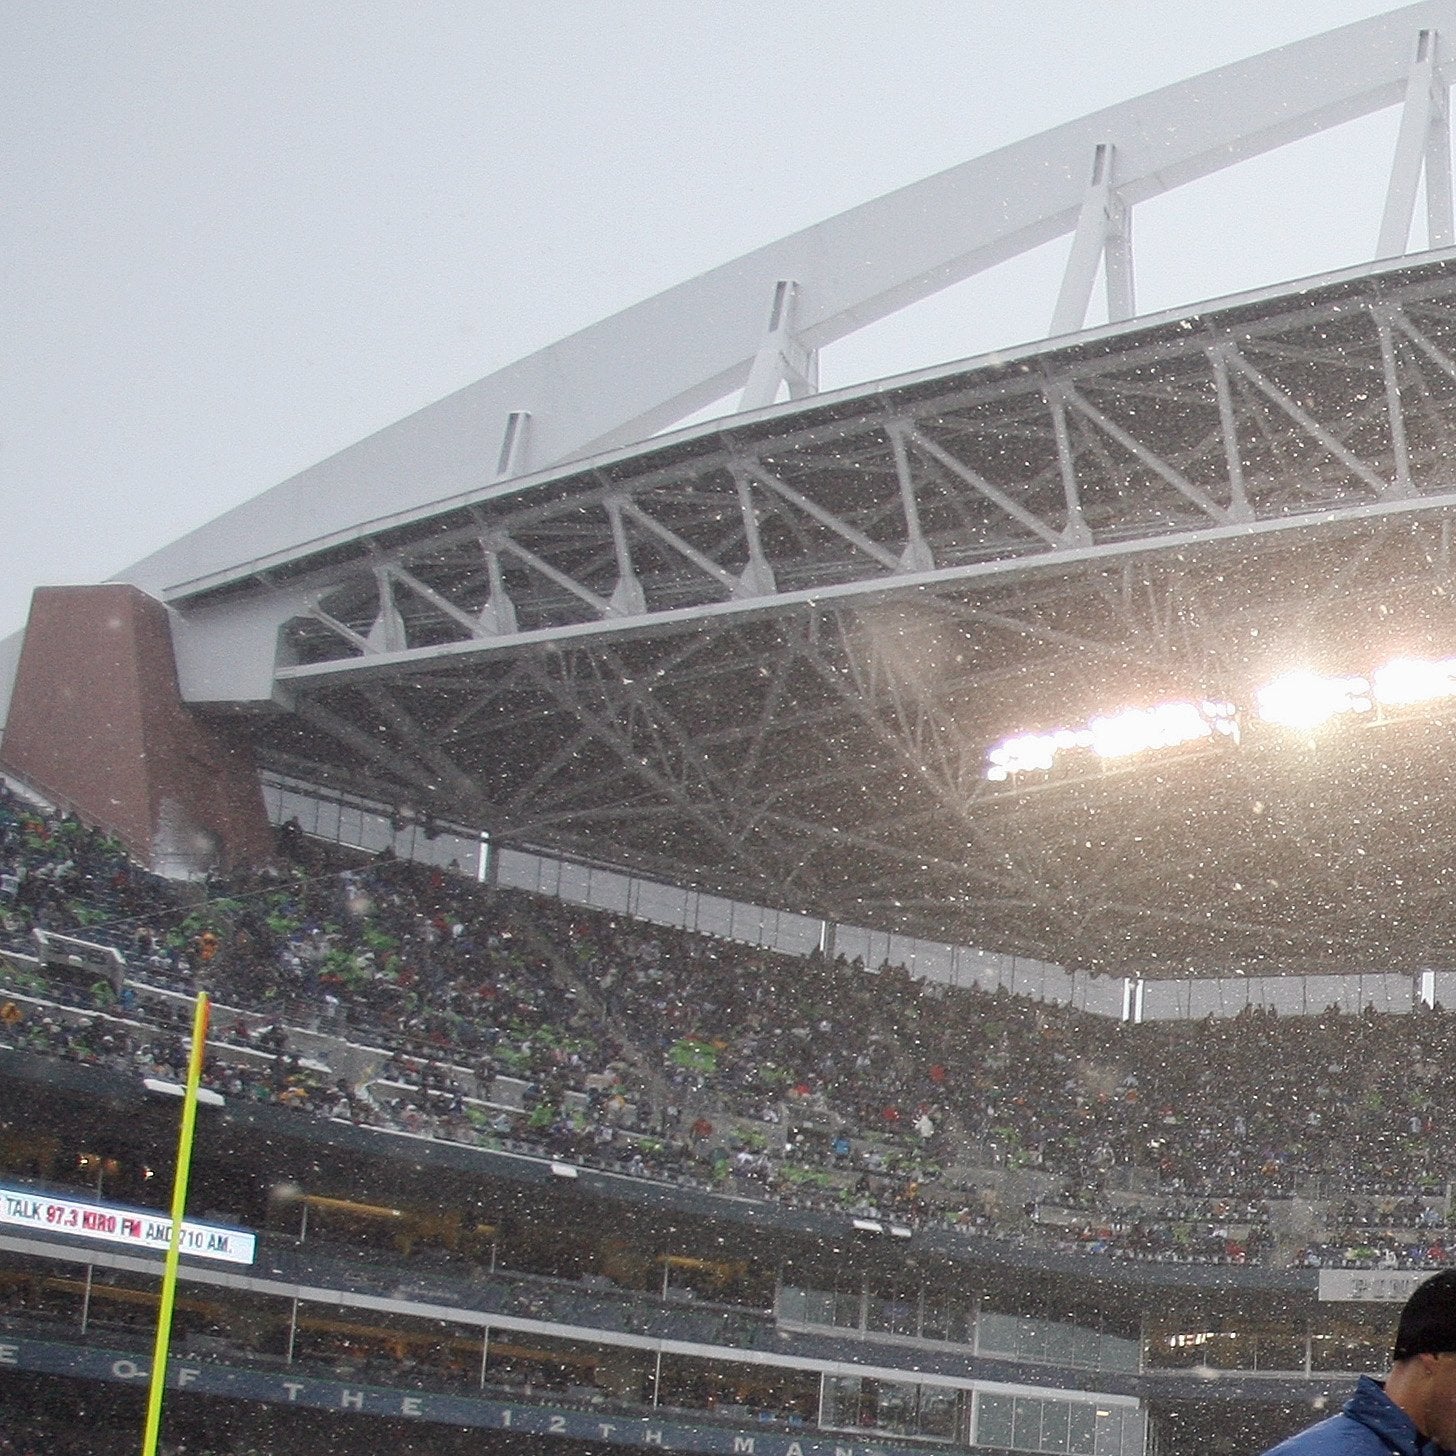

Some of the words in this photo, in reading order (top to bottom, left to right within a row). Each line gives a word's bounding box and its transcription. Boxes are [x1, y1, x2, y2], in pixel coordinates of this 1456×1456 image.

[5, 1197, 43, 1222] TALK
[46, 1205, 78, 1227] 97.3
[82, 1210, 117, 1233] KIRO
[121, 1217, 142, 1239] FM
[113, 1360, 200, 1387] OF
[283, 1383, 423, 1417] THE
[502, 1408, 663, 1445] 12TH
